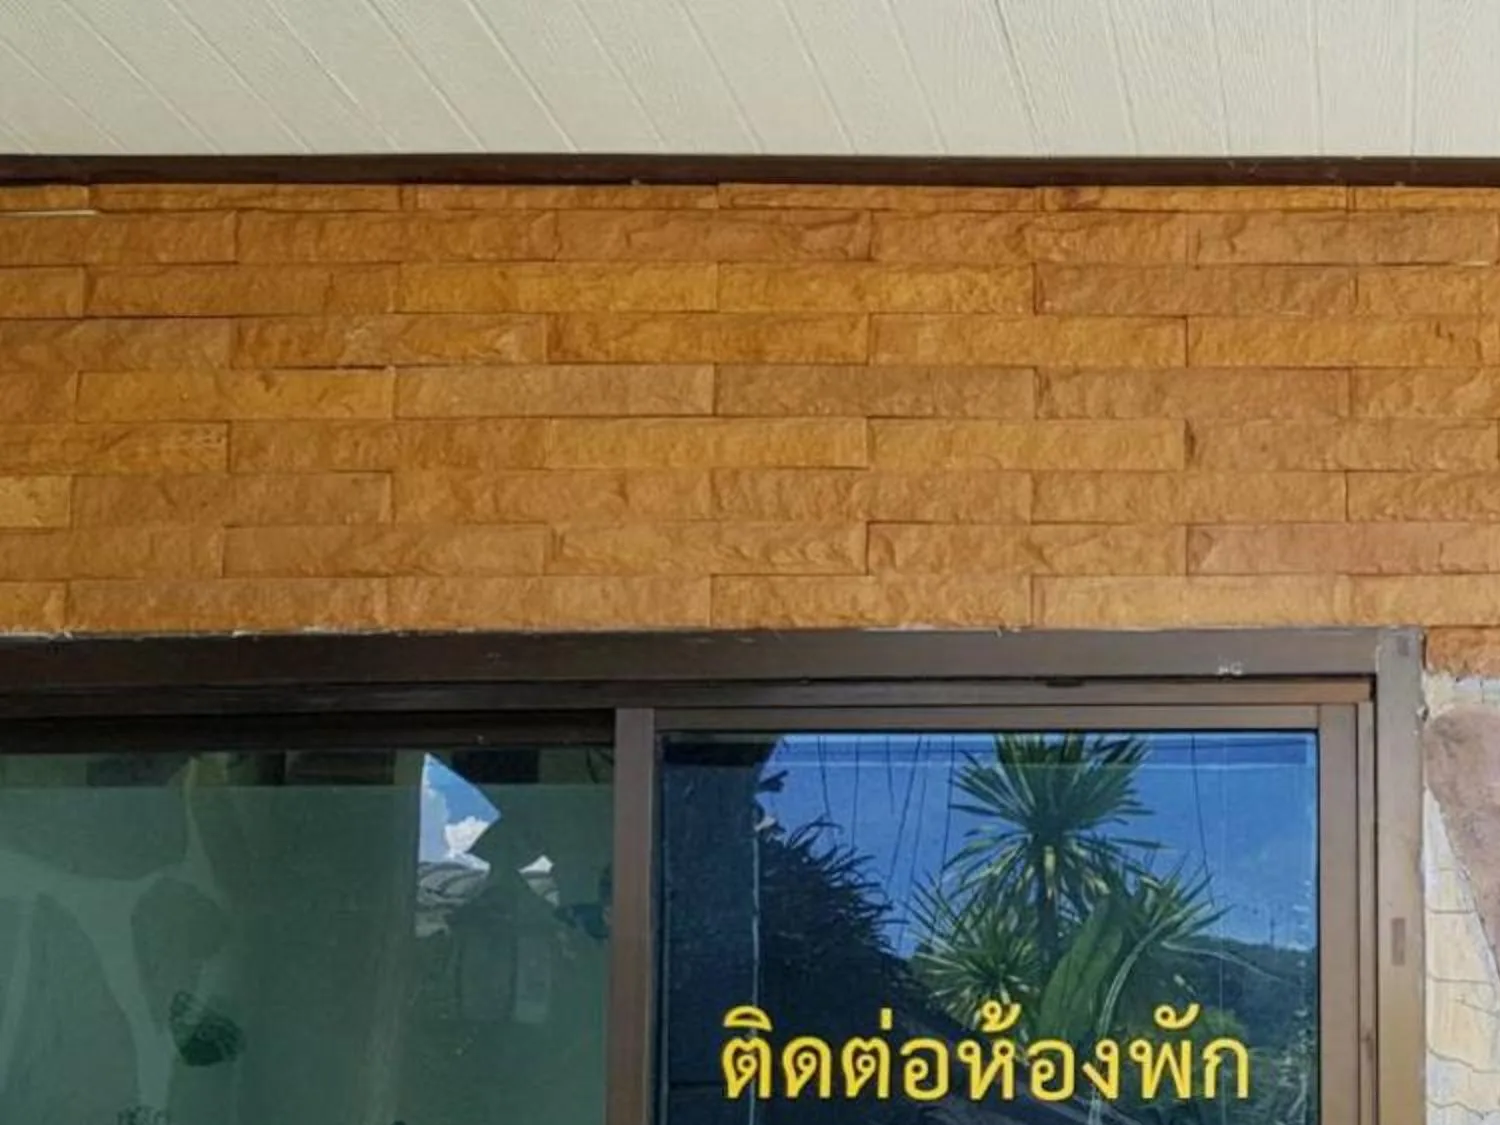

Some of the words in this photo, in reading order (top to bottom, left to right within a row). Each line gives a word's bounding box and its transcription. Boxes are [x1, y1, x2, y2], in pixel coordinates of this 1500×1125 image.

[721, 1000, 1250, 1101] ติดต่อห้องพัก
